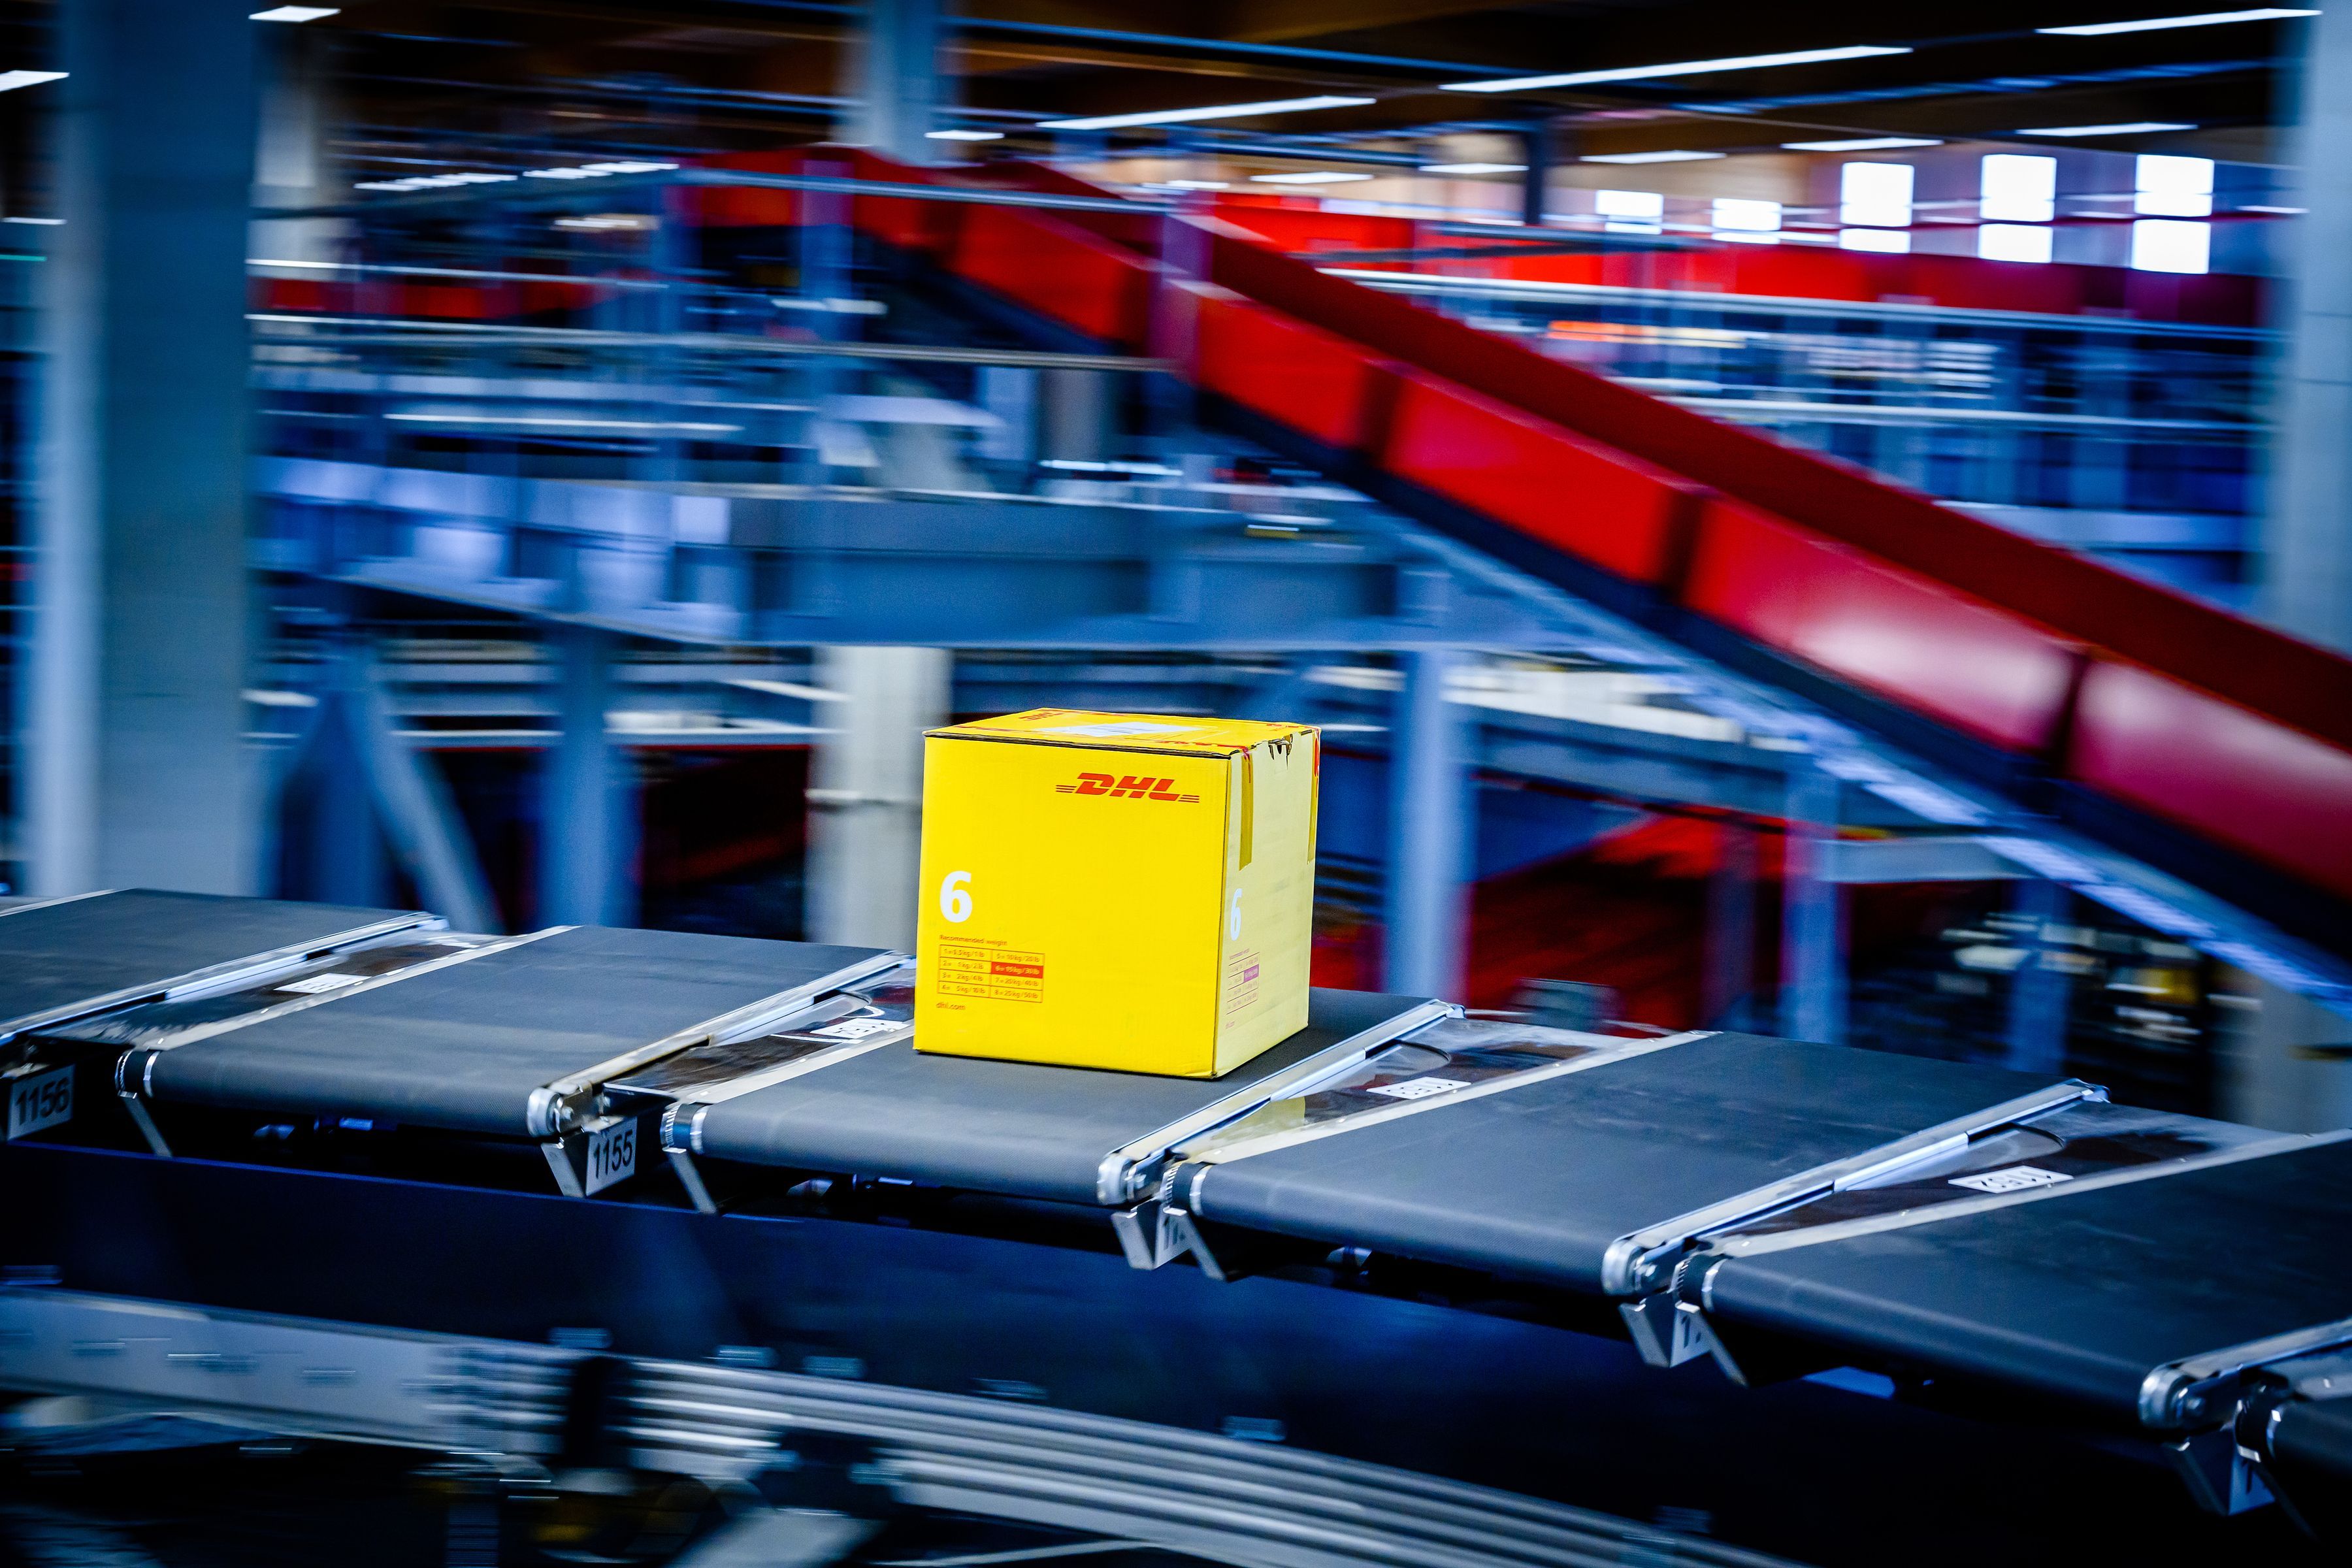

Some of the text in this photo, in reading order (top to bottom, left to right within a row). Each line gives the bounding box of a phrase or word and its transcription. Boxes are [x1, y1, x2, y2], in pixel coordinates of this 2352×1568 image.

[1075, 772, 1183, 802] DHL
[939, 870, 973, 923] 6
[1230, 888, 1243, 941] 6
[16, 1076, 70, 1126] 1156
[593, 1128, 633, 1179] 1155
